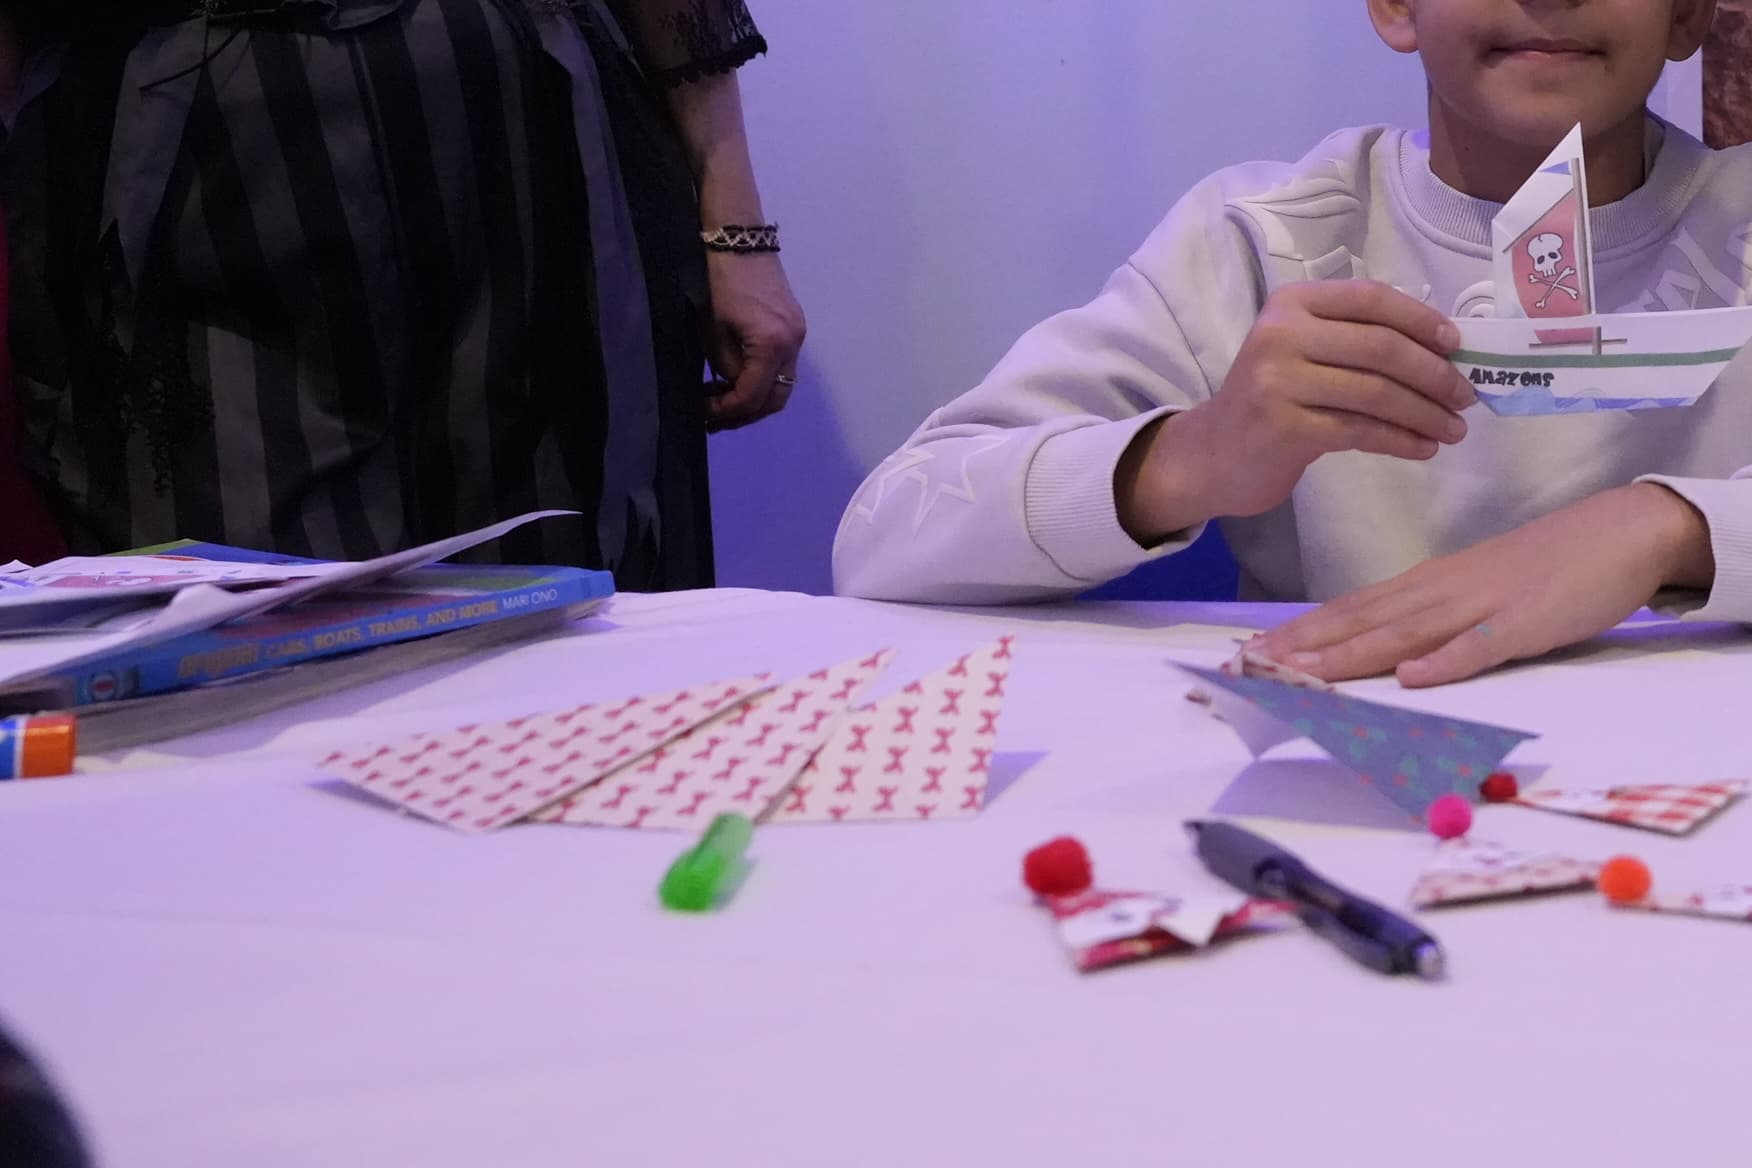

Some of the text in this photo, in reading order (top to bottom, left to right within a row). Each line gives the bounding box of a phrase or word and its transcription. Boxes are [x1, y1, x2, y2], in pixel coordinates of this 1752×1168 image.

[502, 588, 558, 609] MARI ONO
[426, 608, 456, 626] AND
[459, 599, 497, 620] MORE
